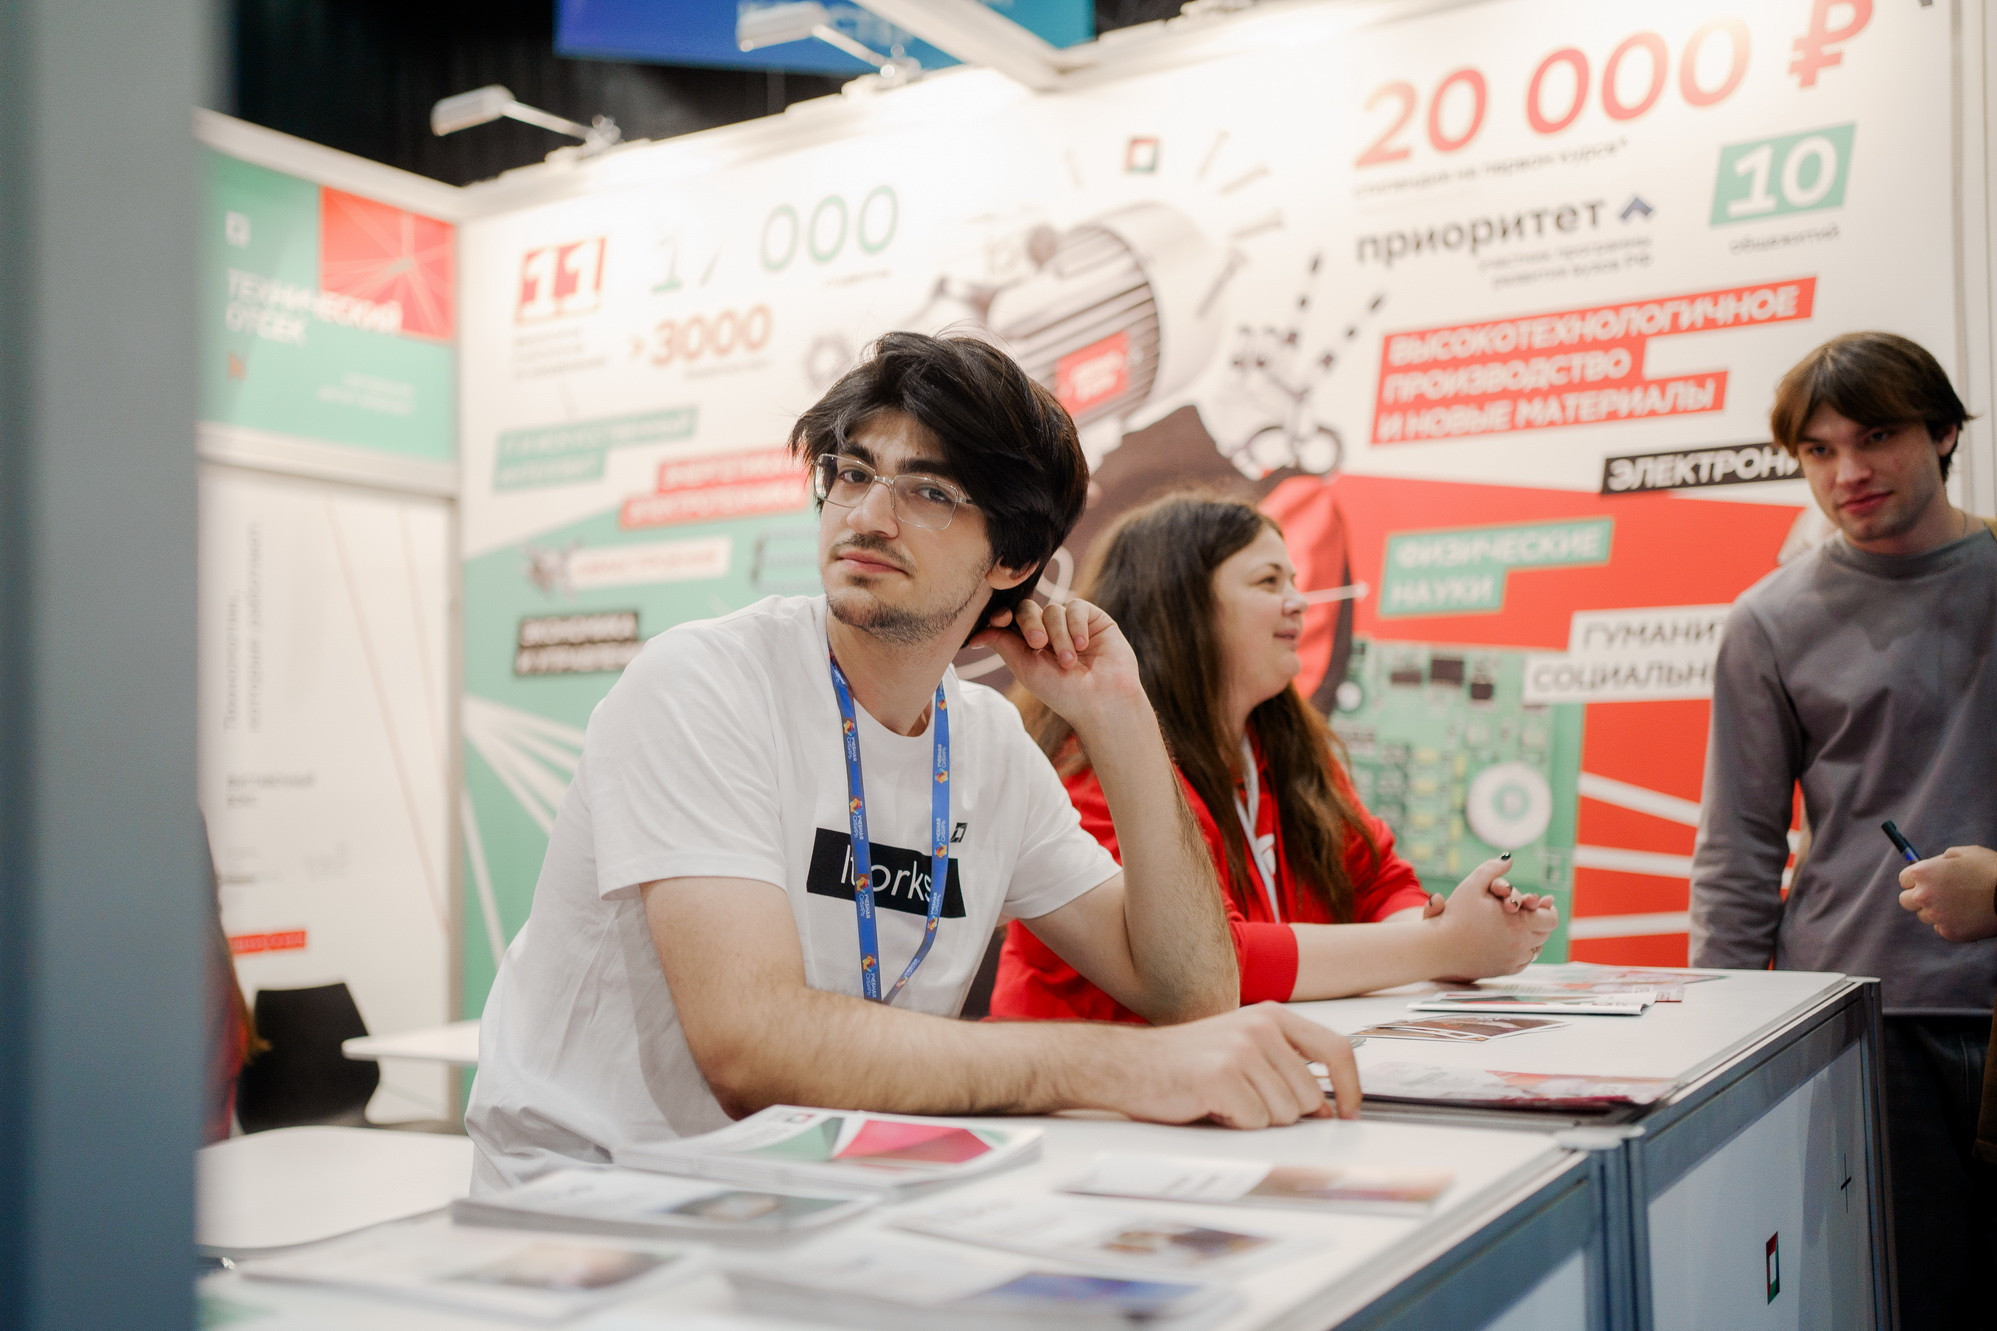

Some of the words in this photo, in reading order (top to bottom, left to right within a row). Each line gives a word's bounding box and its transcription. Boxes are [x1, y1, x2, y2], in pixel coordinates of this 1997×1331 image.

[1354, 68, 1487, 169] 20
[1526, 15, 1751, 135] 000
[1727, 135, 1838, 217] 10
[1356, 199, 1606, 268] приоритет
[1388, 285, 1799, 366] ВЫСОКОТЕХНОЛОГИЧНОЕ
[1383, 348, 1632, 405] ПРОИЗВОДСТВО
[1378, 413, 1402, 442] И
[1406, 398, 1512, 439] НОВЫЕ
[1516, 379, 1715, 428] МАТЕРИАЛЫ
[1396, 526, 1602, 569] ФИЗИЧЕСКИЕ
[1390, 573, 1494, 608] НАУКИ
